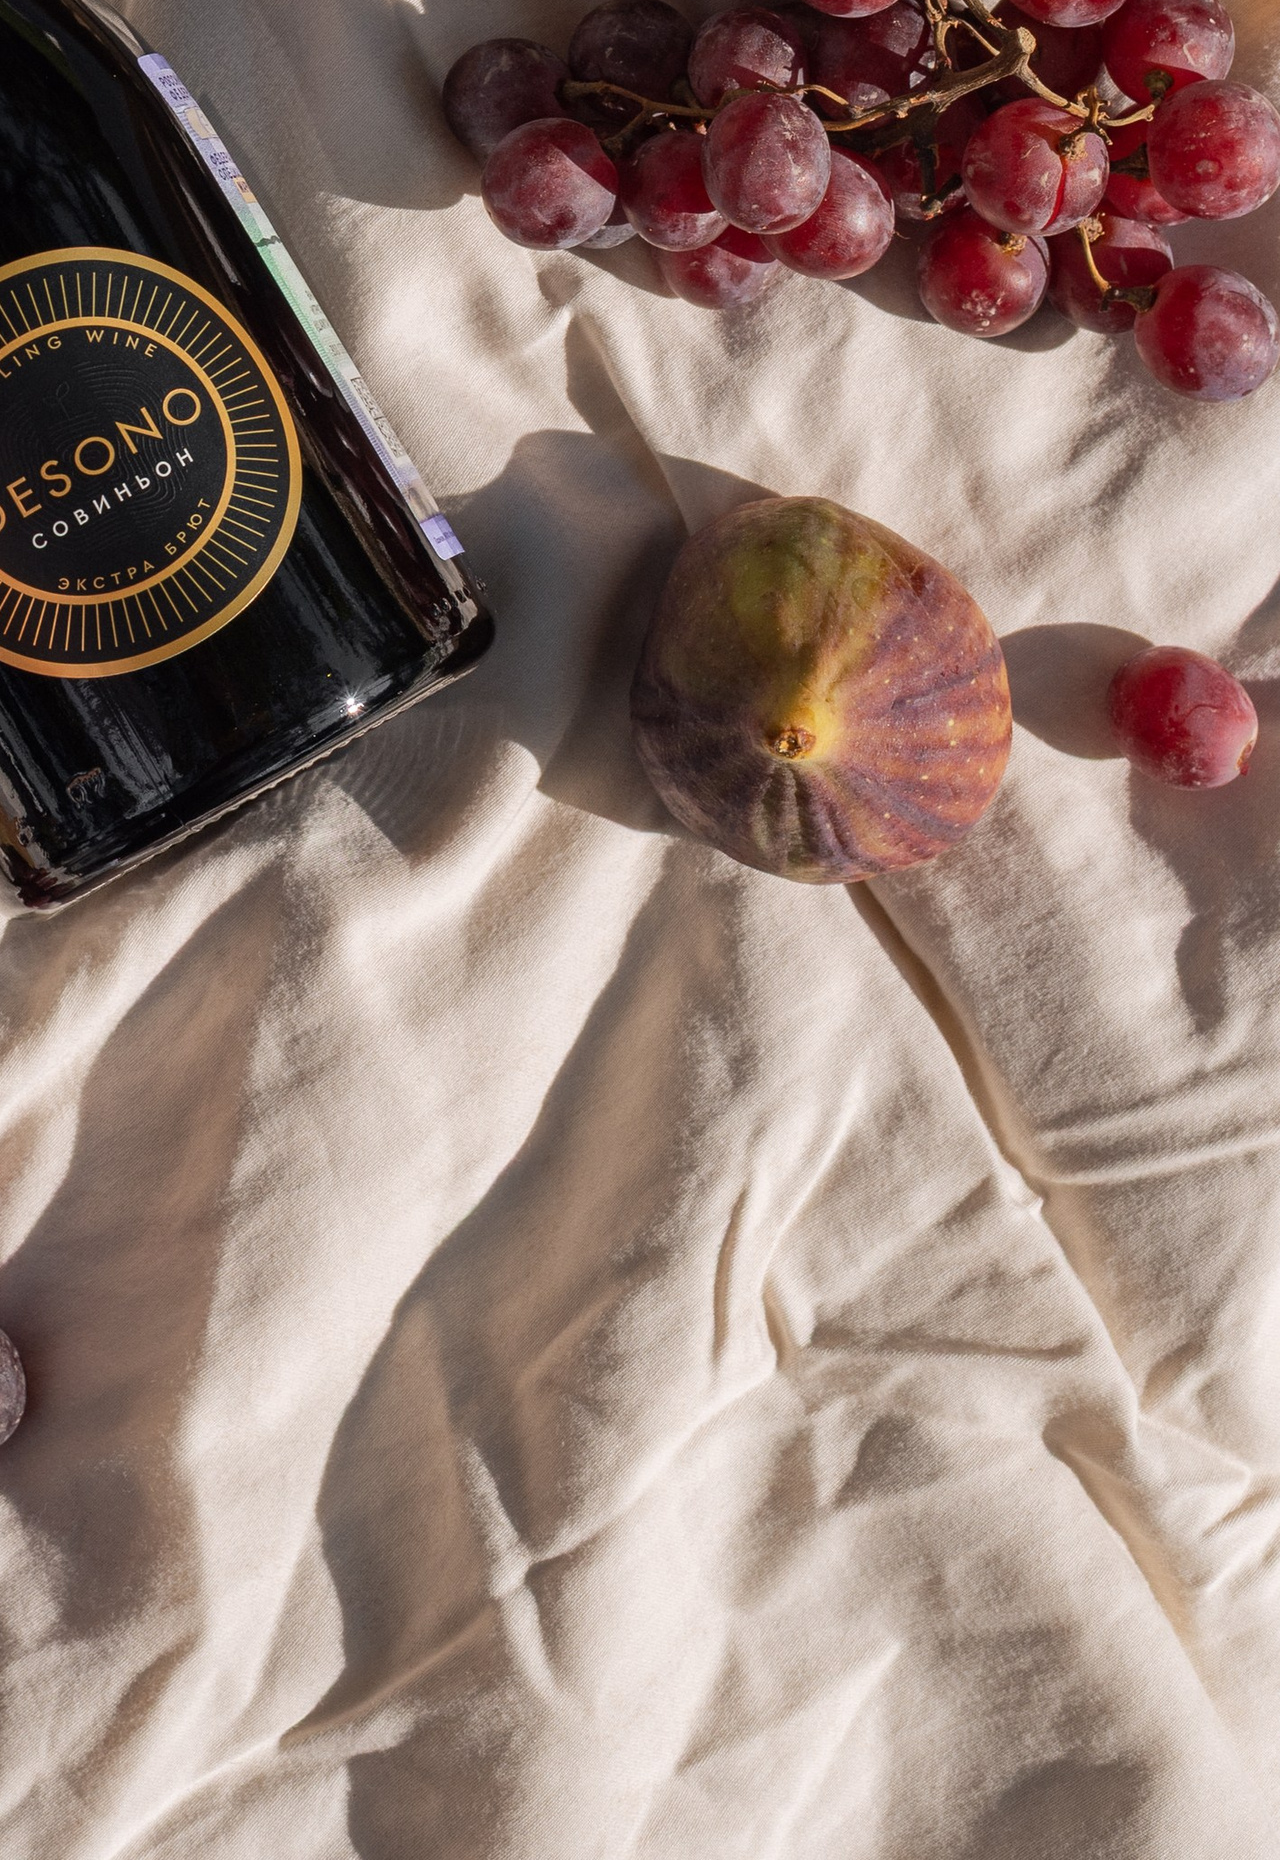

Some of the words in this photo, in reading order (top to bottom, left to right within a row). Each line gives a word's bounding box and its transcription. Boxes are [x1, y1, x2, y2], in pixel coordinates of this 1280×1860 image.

[86, 329, 158, 358] WINE
[32, 448, 194, 549] СОВИНЬОН
[58, 561, 155, 591] ЭКСТРА
[166, 499, 212, 555] БРЮТ
